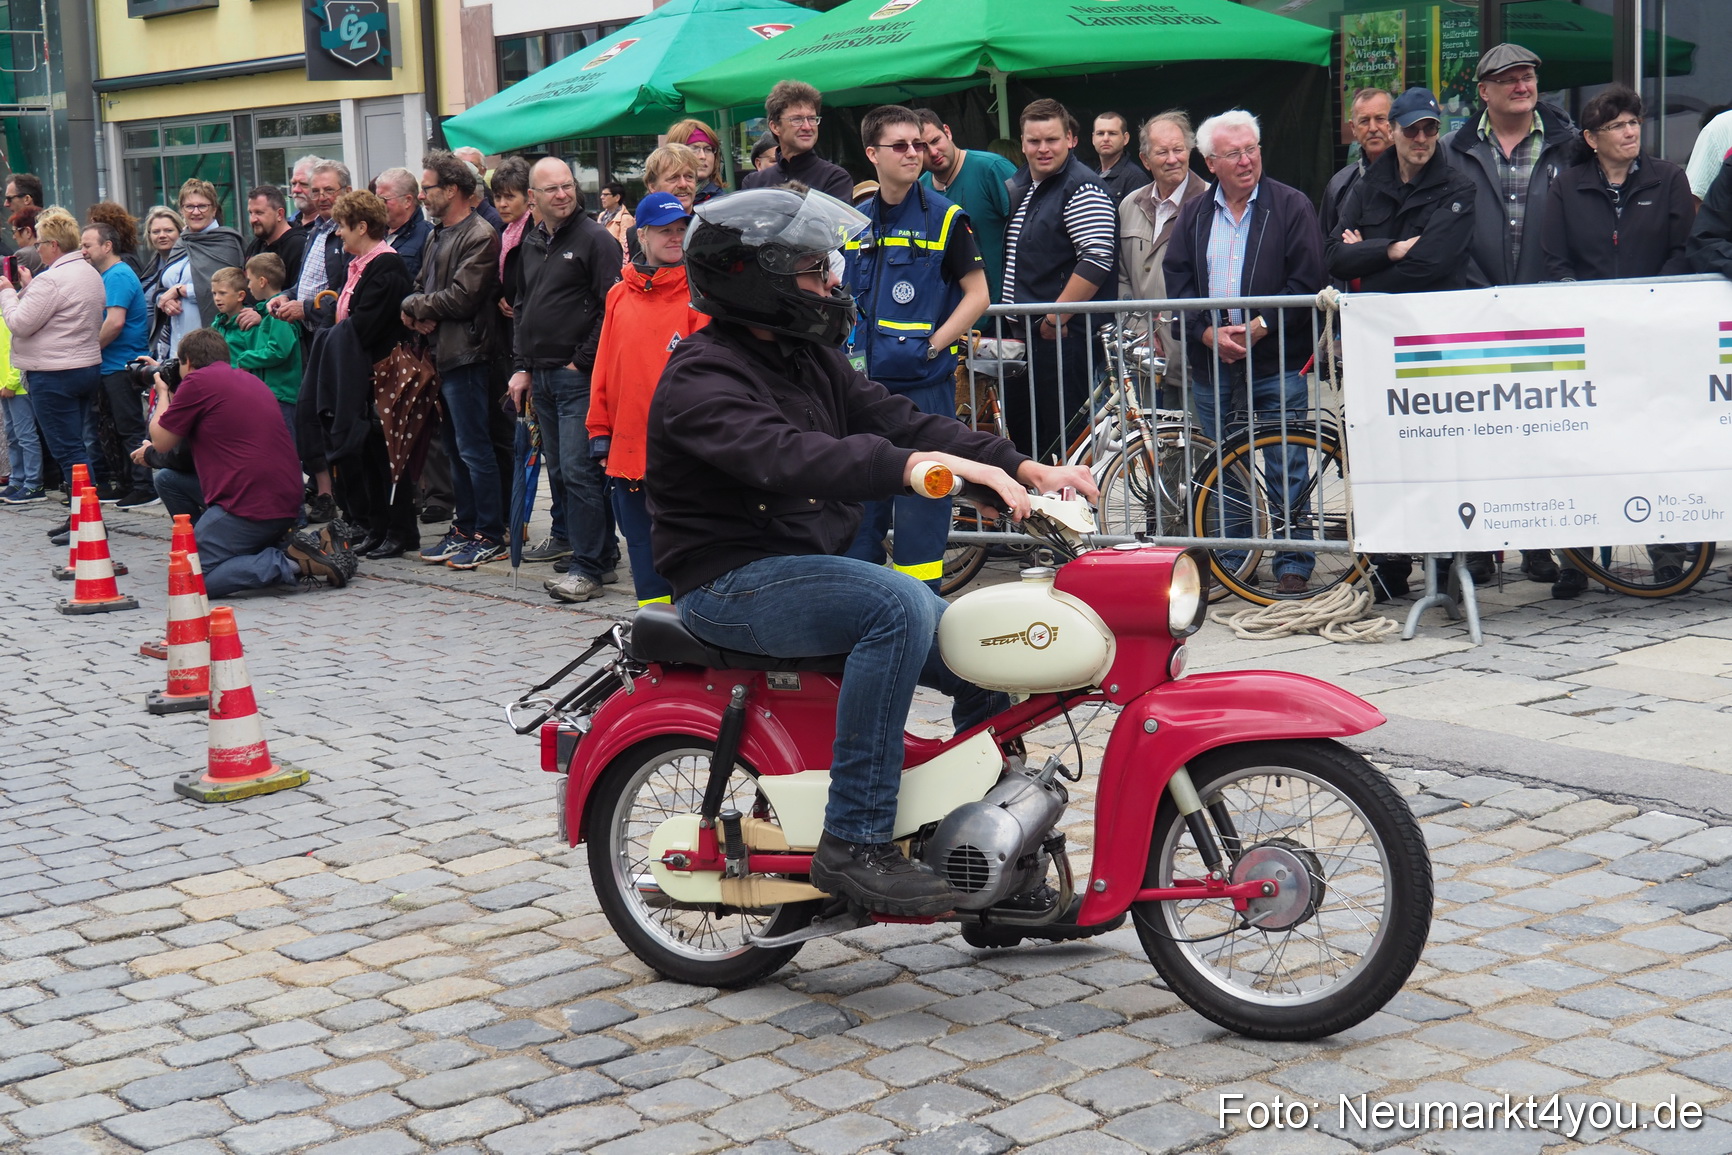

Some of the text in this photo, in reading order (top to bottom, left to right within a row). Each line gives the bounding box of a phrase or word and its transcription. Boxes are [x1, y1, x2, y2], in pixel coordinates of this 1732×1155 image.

[1070, 4, 1180, 13] Neumarkter
[1067, 13, 1222, 27] Lammsbräu
[340, 13, 368, 51] G2
[822, 20, 915, 41] Neumarkter
[776, 31, 912, 61] Lammsbräu
[1350, 34, 1397, 47] Wald- und
[1355, 49, 1392, 59] Wiesen-
[1350, 60, 1396, 73] Kochbuch
[1387, 379, 1597, 415] NeuerMarkt
[1399, 419, 1590, 439] einkaufen leben genießen
[1483, 498, 1576, 514] Dammstraße 1
[1483, 516, 1548, 530] Neumarkt
[1573, 513, 1600, 526] OPf.
[1657, 508, 1725, 523] 10-20 Uhr
